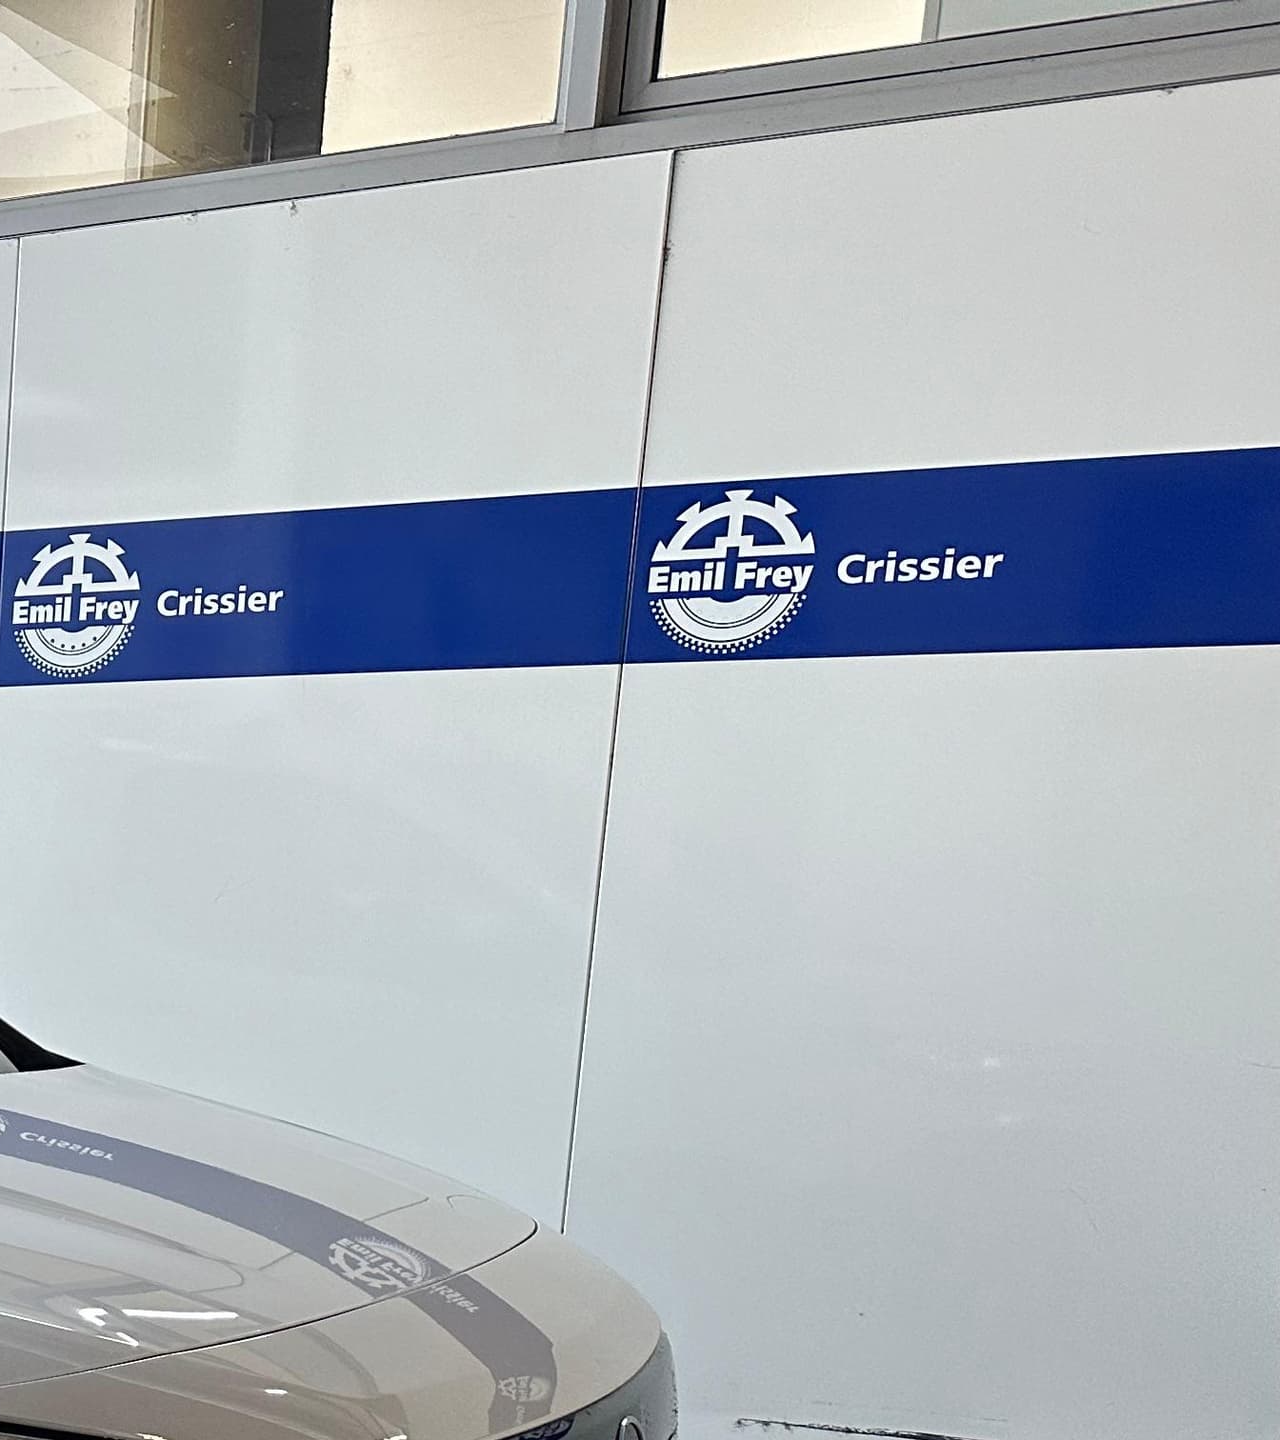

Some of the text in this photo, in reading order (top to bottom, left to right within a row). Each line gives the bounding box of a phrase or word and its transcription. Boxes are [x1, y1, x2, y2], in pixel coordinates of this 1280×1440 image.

[647, 561, 815, 594] Emil Frey
[837, 548, 1005, 585] Crissier
[12, 596, 140, 625] Emil Frey
[156, 585, 284, 617] Crissier
